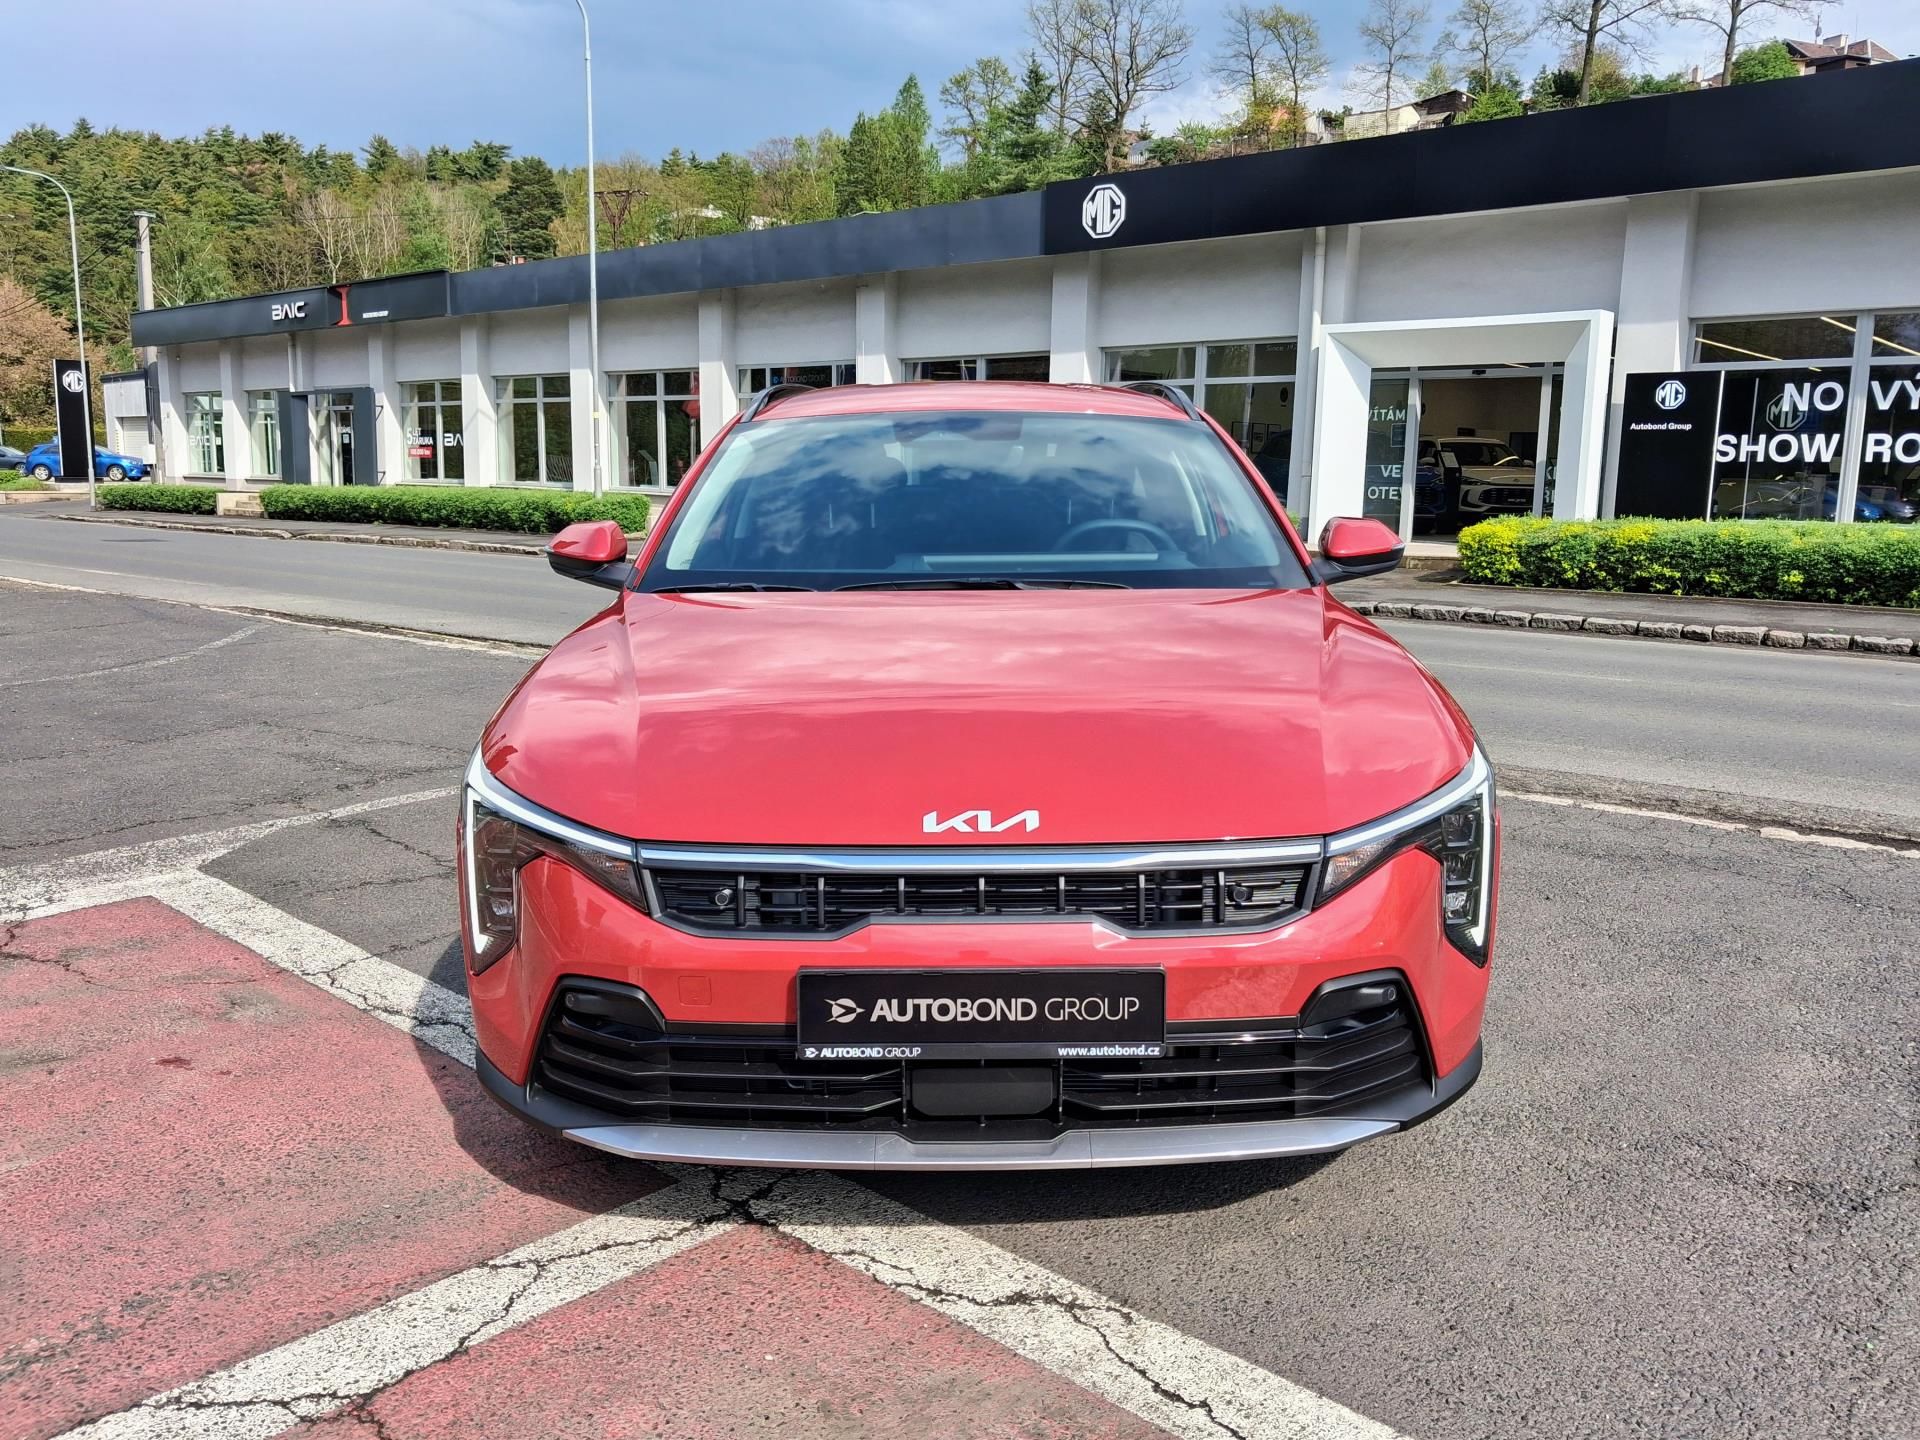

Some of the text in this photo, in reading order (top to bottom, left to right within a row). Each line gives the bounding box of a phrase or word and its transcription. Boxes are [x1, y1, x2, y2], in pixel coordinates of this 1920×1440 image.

[1085, 187, 1122, 236] MG
[272, 302, 306, 321] BAIC
[64, 371, 84, 391] MG
[1657, 382, 1685, 408] MG
[1782, 381, 1844, 412] NO
[1630, 422, 1692, 431] Autobond Group
[923, 810, 1039, 832] KIA
[870, 997, 1139, 1022] AUTOBOND GROUP
[820, 1047, 921, 1058] AUTOBOND GROUP
[1058, 1045, 1160, 1056] www.autobond.cz
